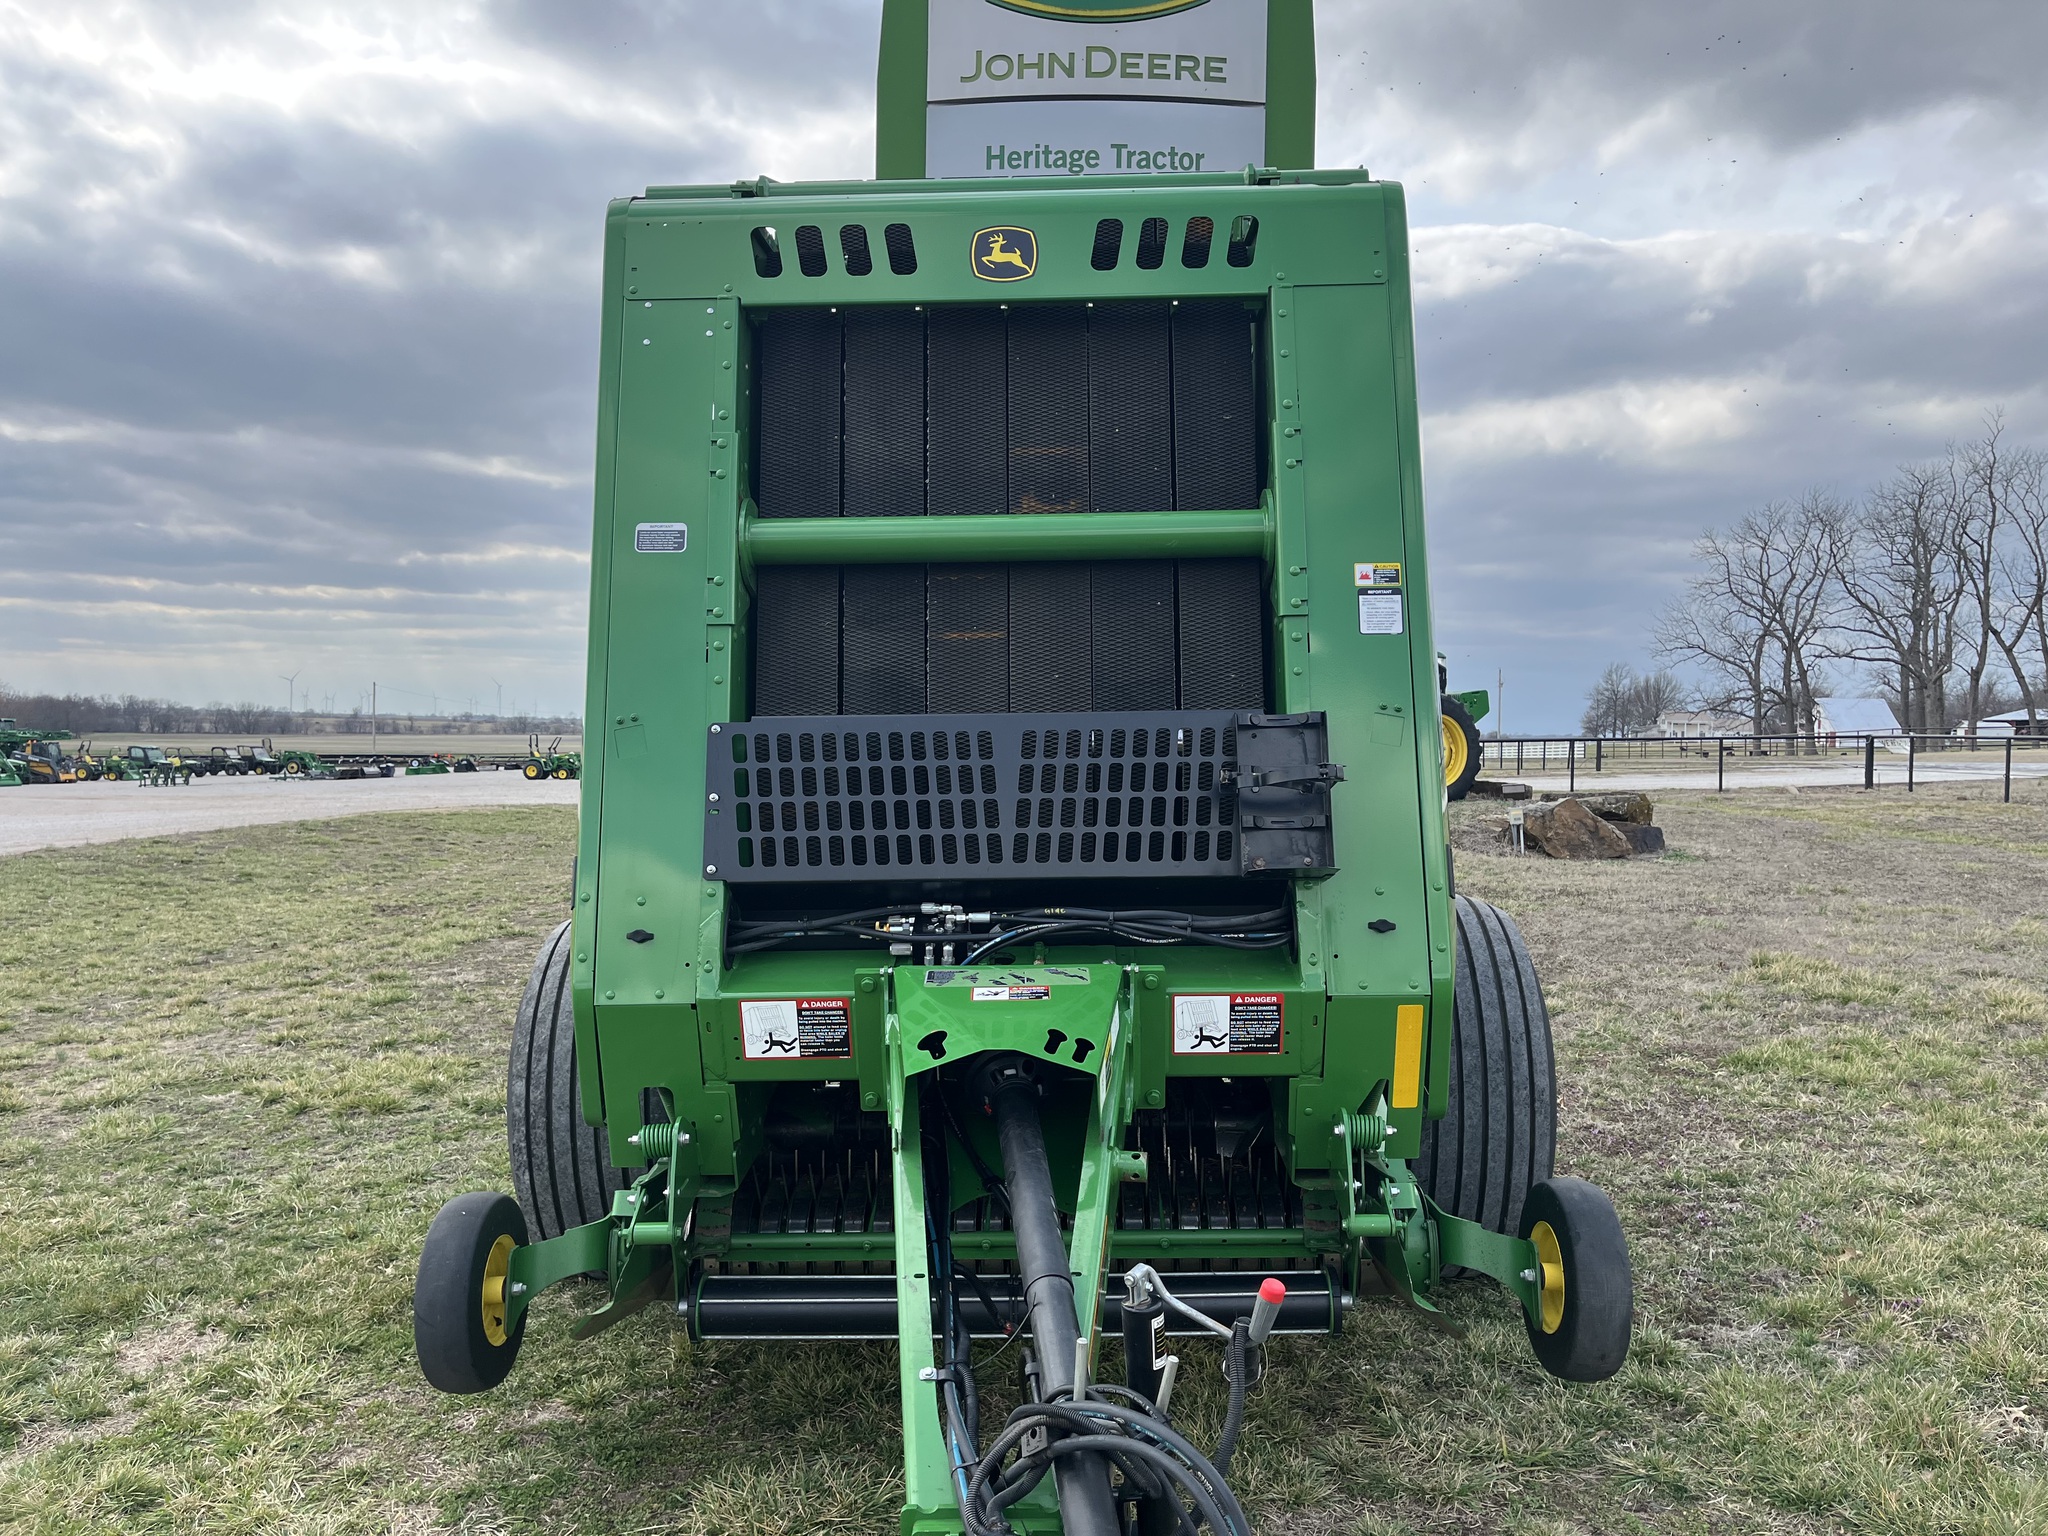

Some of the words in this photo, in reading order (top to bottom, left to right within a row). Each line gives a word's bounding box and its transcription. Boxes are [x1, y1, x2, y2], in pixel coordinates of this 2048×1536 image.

[960, 50, 1075, 83] JOHN
[1085, 46, 1228, 83] DEERE
[985, 144, 1100, 174] Heritage
[1110, 144, 1205, 171] Tractor
